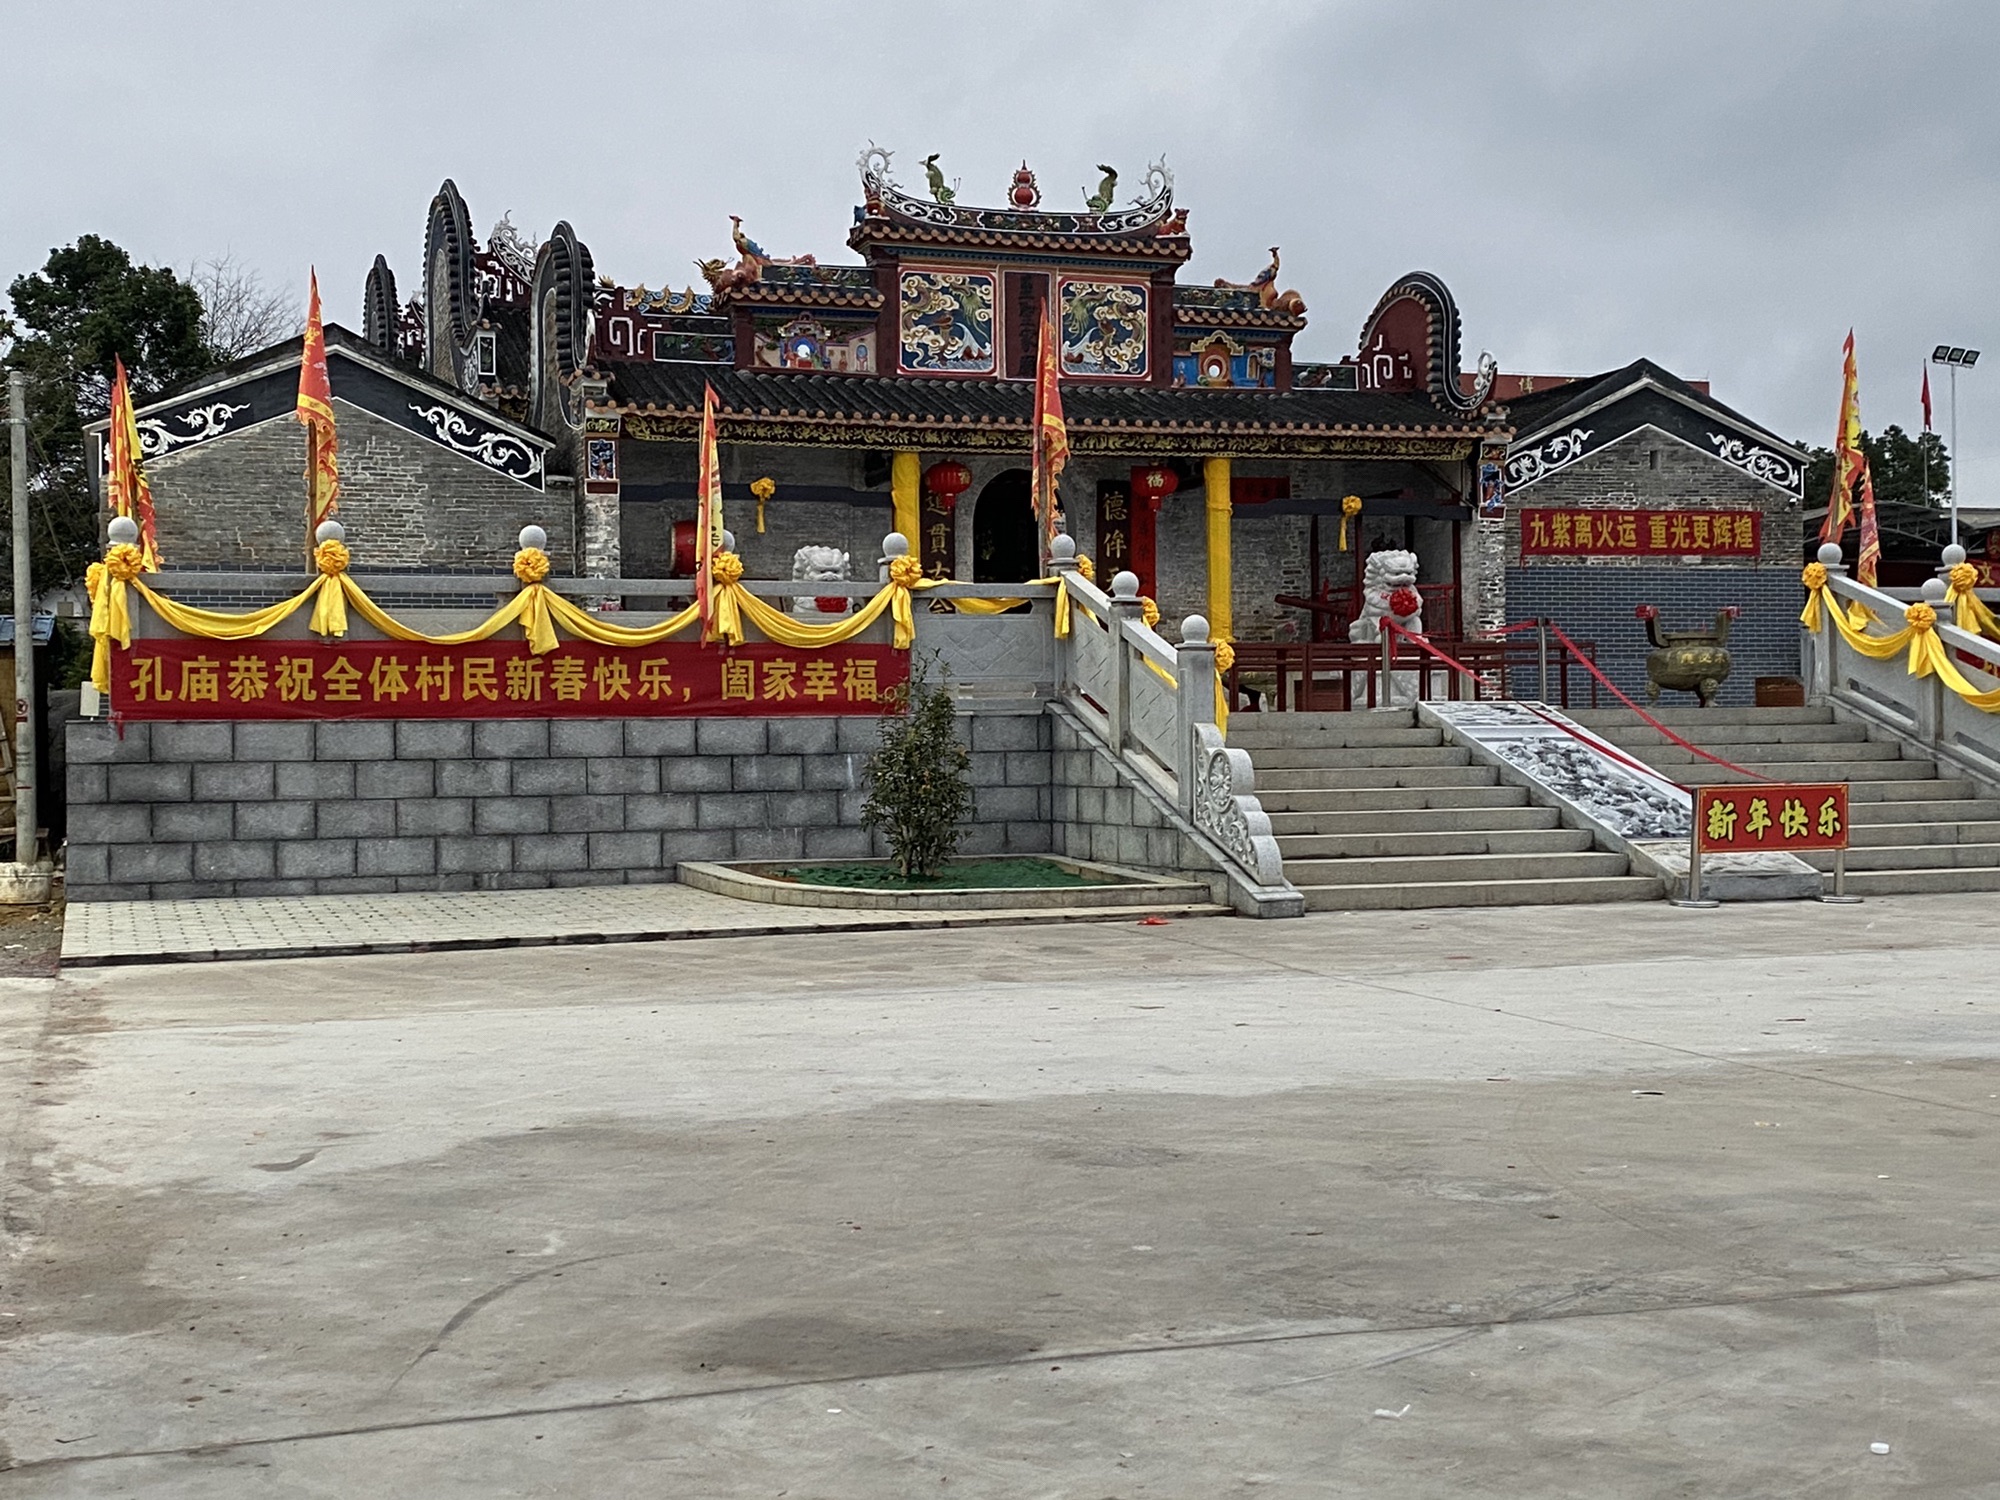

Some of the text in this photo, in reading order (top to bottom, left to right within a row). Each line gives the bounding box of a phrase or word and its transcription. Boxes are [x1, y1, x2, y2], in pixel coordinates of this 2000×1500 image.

[1146, 471, 1164, 488] 福
[1530, 513, 1754, 549] 九紫离火运 重光更辉煌
[1707, 796, 1842, 841] 新年快乐
